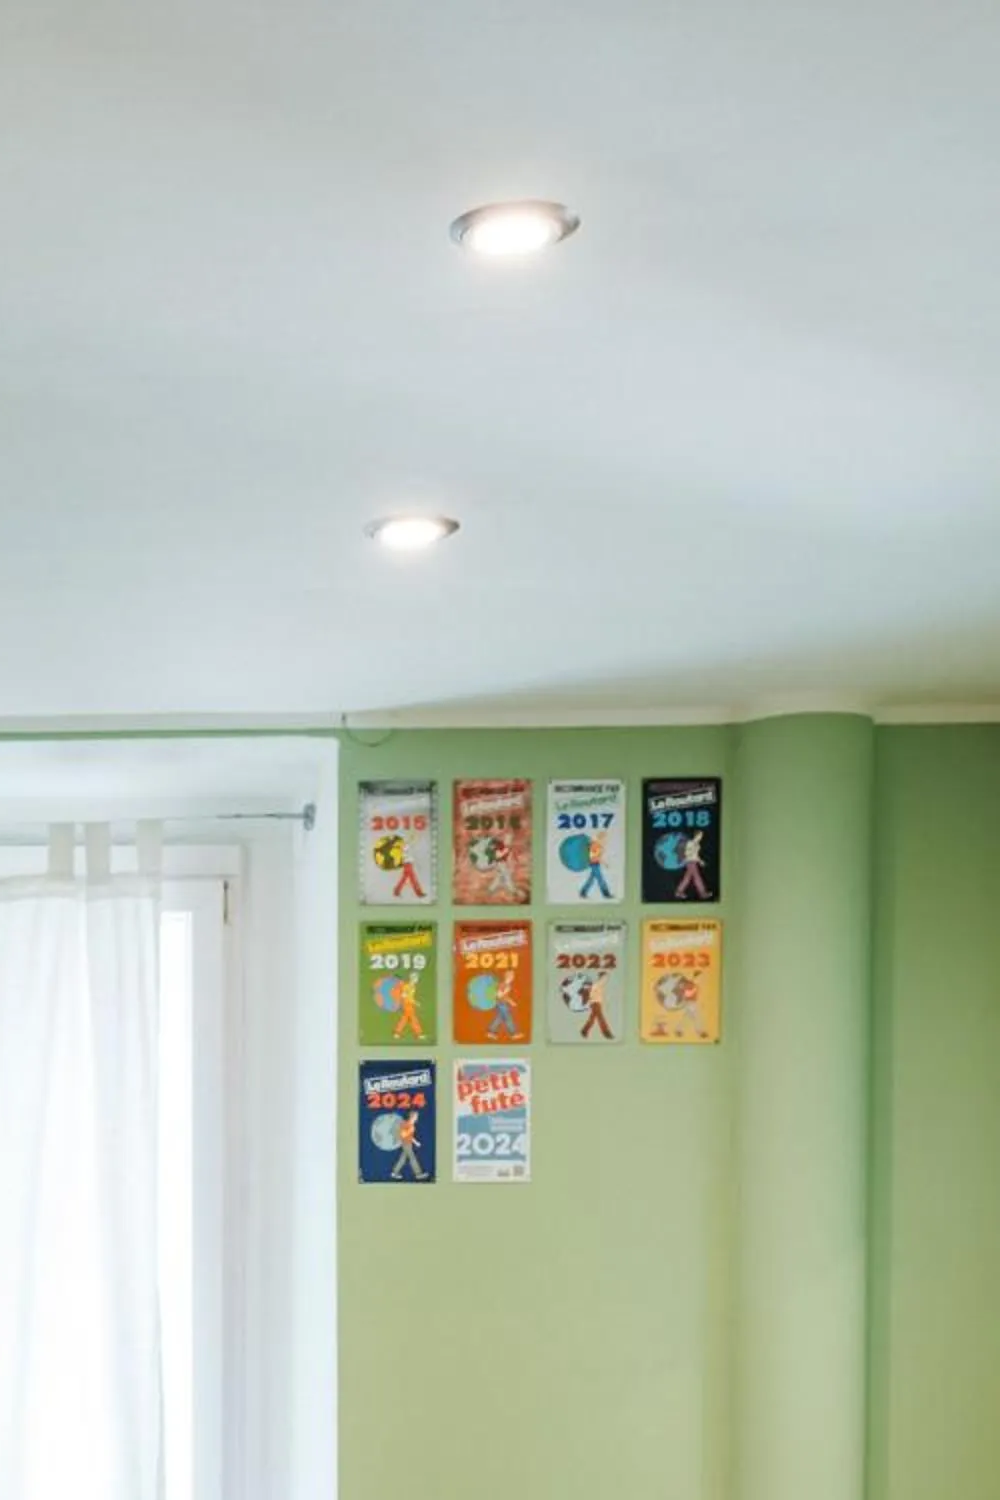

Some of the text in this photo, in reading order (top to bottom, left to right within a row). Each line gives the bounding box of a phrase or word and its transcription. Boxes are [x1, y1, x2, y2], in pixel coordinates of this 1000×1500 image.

[558, 812, 614, 829] 2017
[652, 810, 710, 828] 2018
[370, 954, 427, 970] 2019
[465, 953, 520, 969] 2021
[556, 953, 616, 969] 2022
[652, 953, 710, 968] 2023
[457, 1067, 521, 1102] petit
[367, 1092, 427, 1109] 2024
[457, 1132, 526, 1156] 2024
